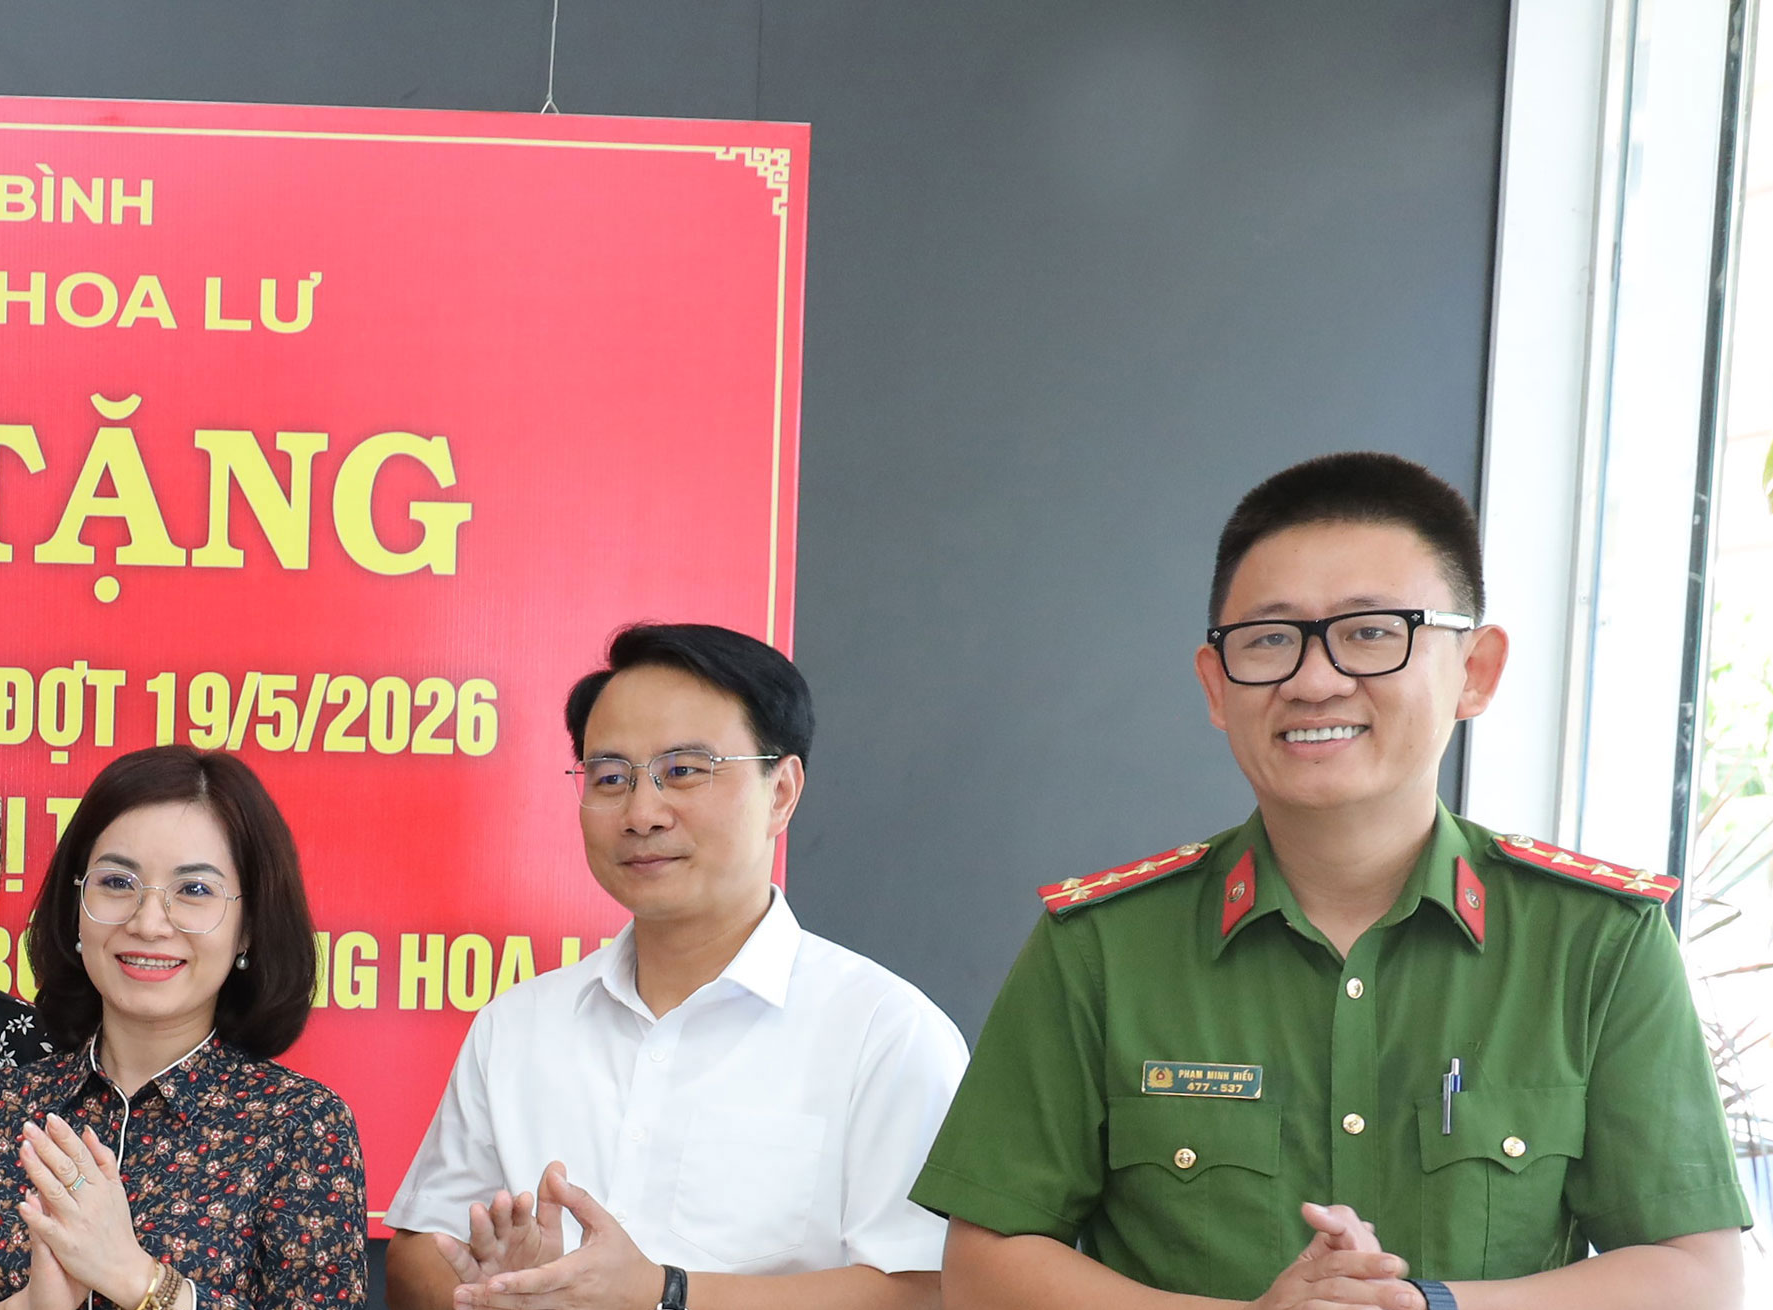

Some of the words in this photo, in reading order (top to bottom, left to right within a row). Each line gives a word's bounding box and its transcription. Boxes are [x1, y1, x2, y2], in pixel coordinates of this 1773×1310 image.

[203, 271, 323, 334] LƯ
[145, 670, 500, 758] 19/5/2026
[398, 933, 537, 1012] HOA
[1178, 1069, 1204, 1081] PHẠM
[1207, 1071, 1230, 1080] MINH
[1187, 1082, 1210, 1092] 477
[1220, 1084, 1244, 1093] 537
